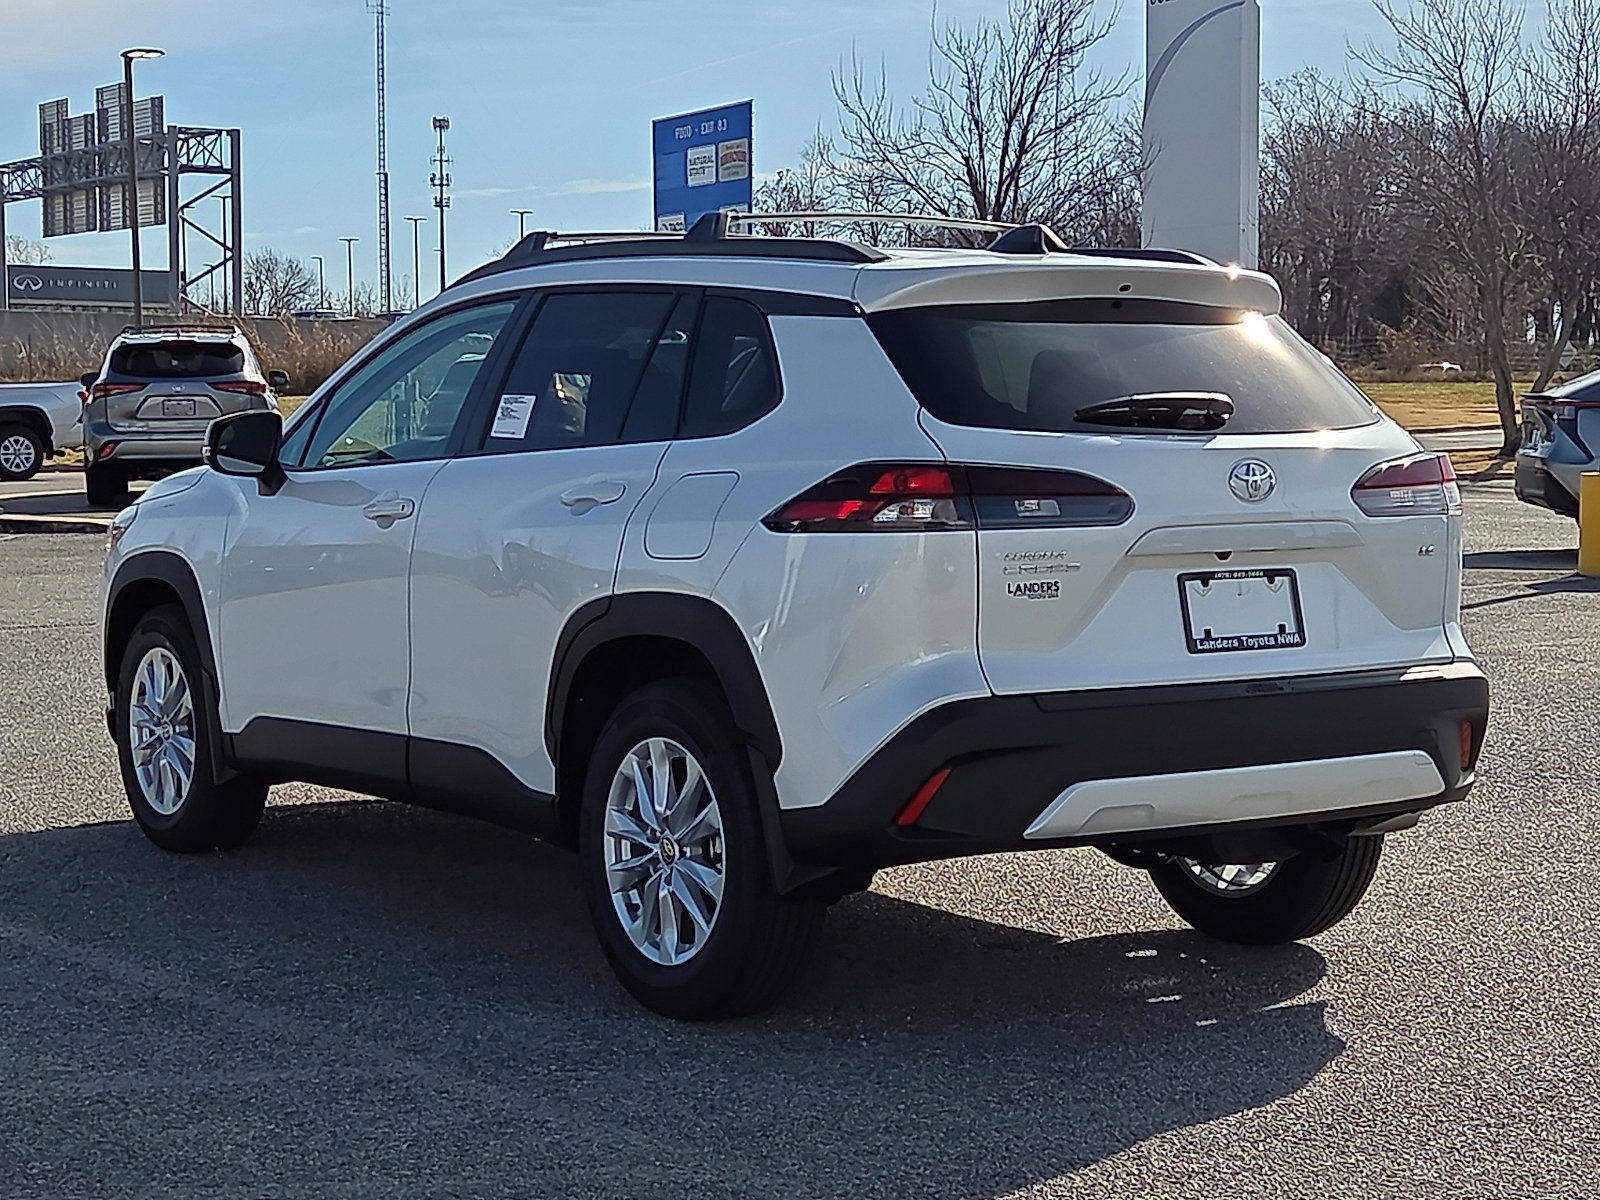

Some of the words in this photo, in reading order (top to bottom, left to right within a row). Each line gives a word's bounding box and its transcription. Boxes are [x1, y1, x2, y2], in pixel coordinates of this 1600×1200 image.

[48, 279, 118, 289] INFINITI
[1007, 580, 1060, 597] LANDERS
[1196, 638, 1239, 650] Landers
[1240, 636, 1275, 648] Toyota
[1277, 633, 1302, 645] NWA
